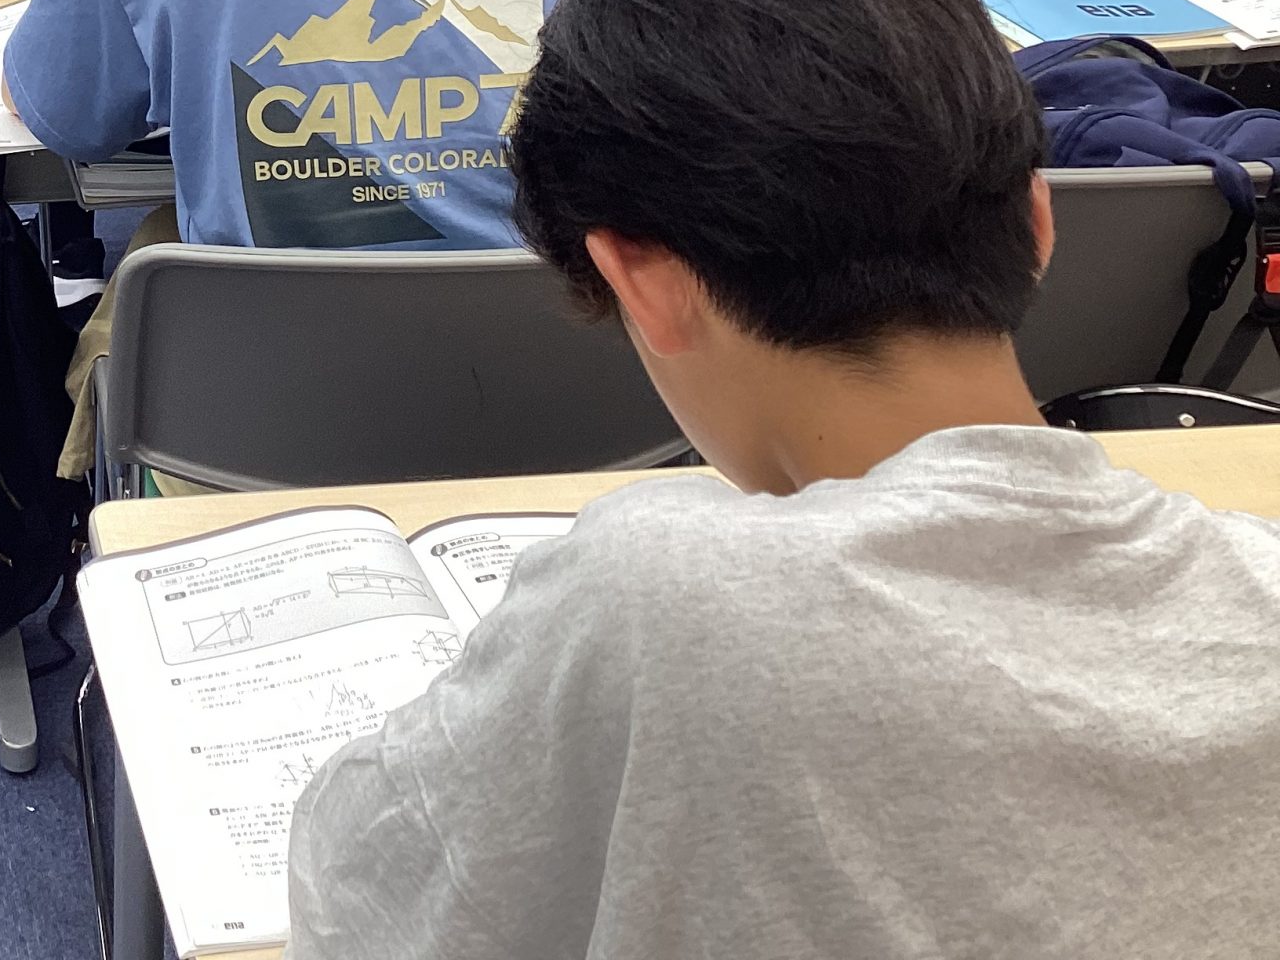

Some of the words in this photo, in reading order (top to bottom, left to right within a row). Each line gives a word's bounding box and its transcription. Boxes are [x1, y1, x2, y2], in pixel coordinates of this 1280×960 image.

[254, 156, 381, 182] BOULDER
[352, 185, 410, 203] SINCE
[414, 181, 447, 199] 1971
